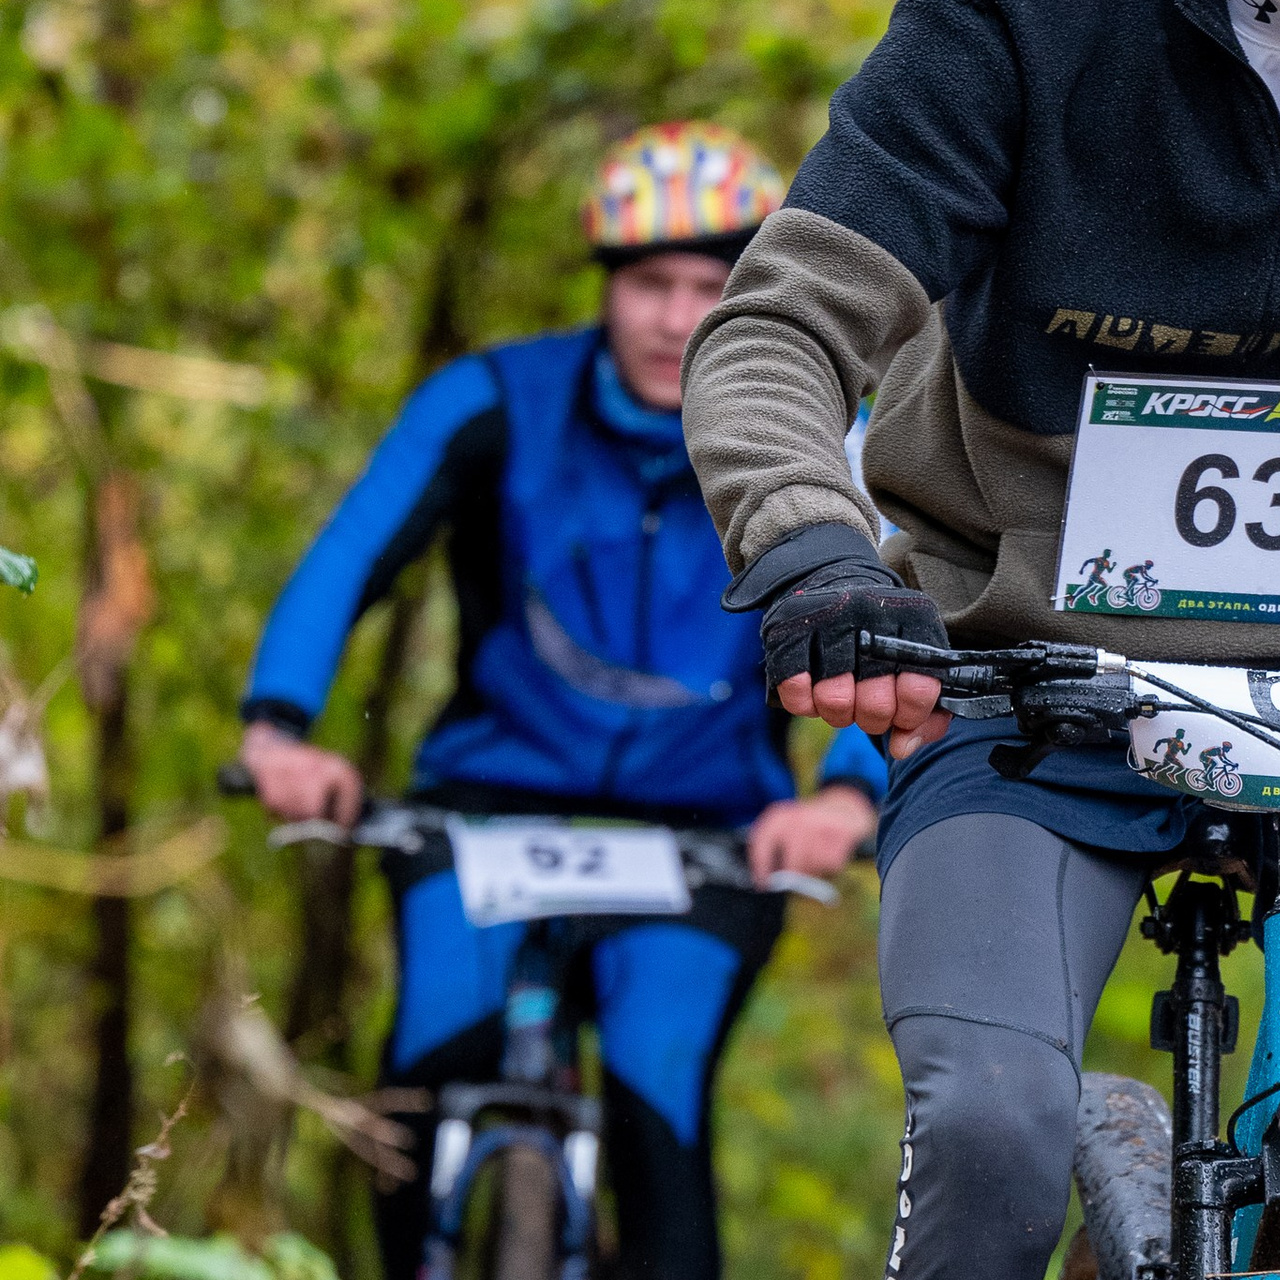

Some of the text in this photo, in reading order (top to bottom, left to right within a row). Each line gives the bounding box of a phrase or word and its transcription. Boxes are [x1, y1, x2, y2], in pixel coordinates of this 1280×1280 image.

[1141, 391, 1261, 419] КРОСС
[1177, 598, 1205, 610] ДВА
[1207, 600, 1256, 612] ЭТАПА.
[1187, 1013, 1202, 1095] BUSTER
